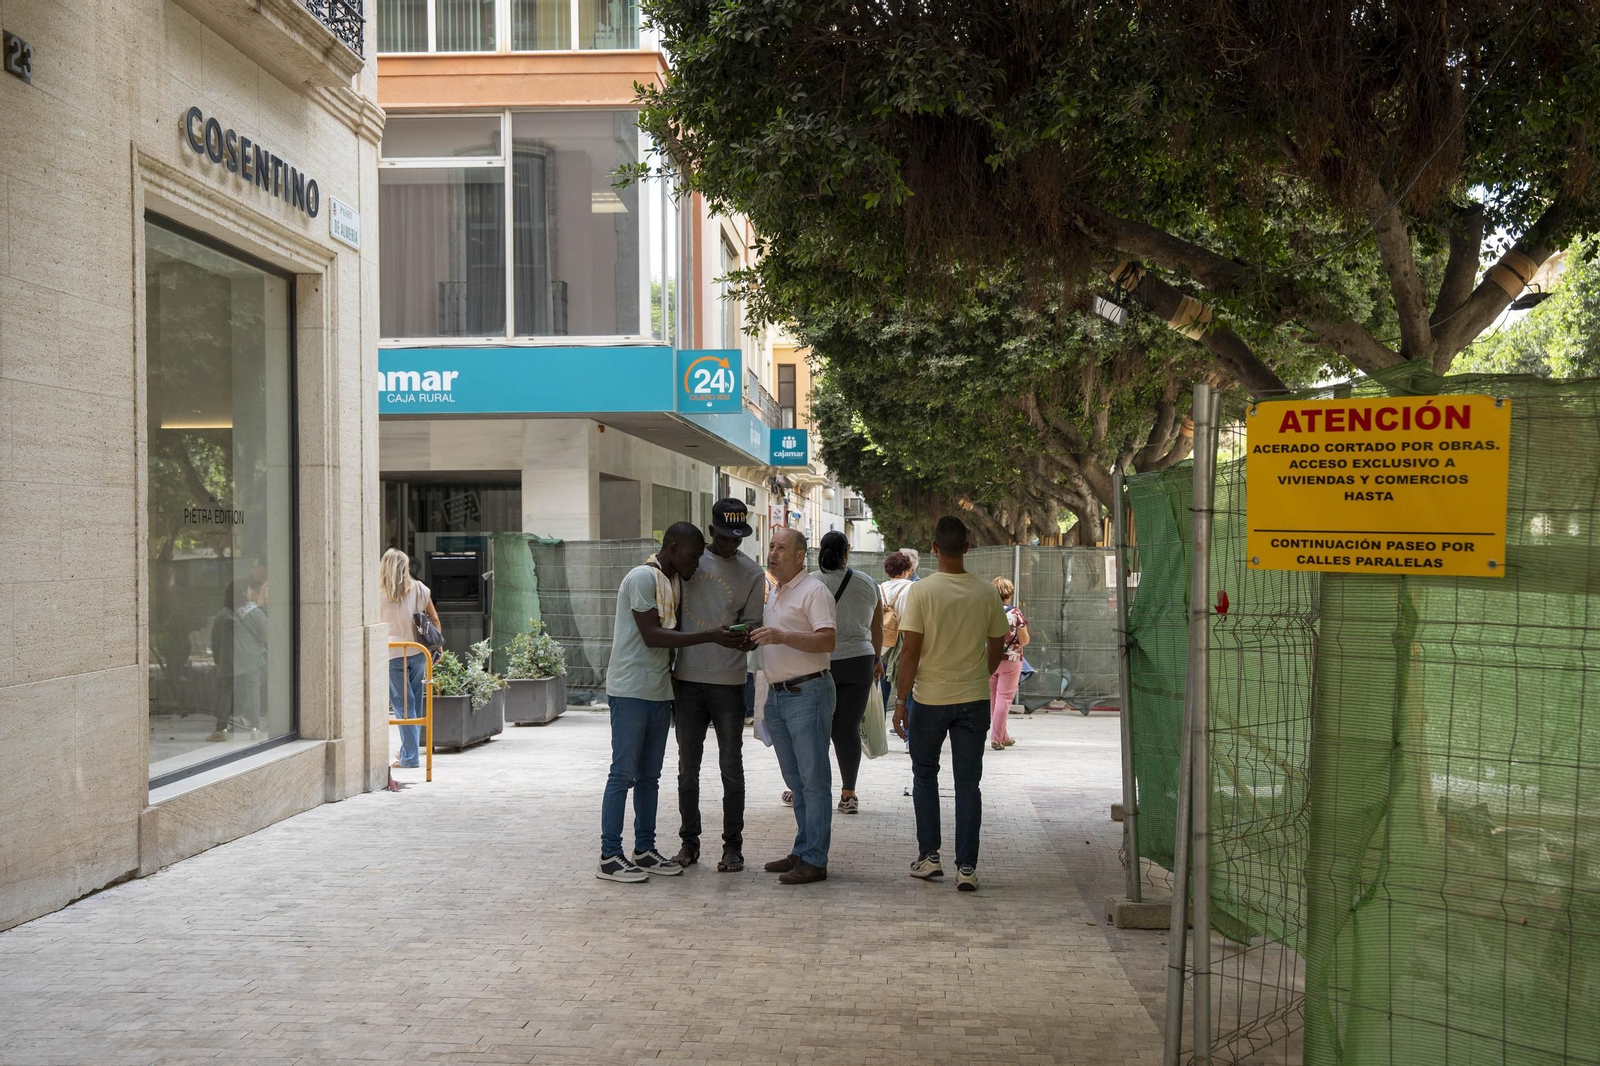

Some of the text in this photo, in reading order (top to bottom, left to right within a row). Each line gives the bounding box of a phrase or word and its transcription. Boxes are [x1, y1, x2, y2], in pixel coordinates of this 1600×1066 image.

[11, 36, 33, 78] 23
[183, 106, 320, 218] COSENTINO
[334, 219, 340, 235] DE
[387, 393, 456, 403] CAJA RURAL
[1278, 400, 1471, 433] ATENCIÓN
[1252, 440, 1500, 454] ACERADO CORTADO POR OBRAS.
[773, 450, 805, 459] cajamar
[1289, 458, 1456, 469] ACCESO EXCLUSIVO A
[1277, 474, 1469, 485] VIVIENDAS Y COMERCIOS
[1344, 491, 1394, 501] HASTA
[184, 508, 244, 525] PIETRA EDITION
[1270, 538, 1475, 552] CONTINUACIÓN PASEO POR
[1296, 555, 1444, 568] CALLES PARALELAS
